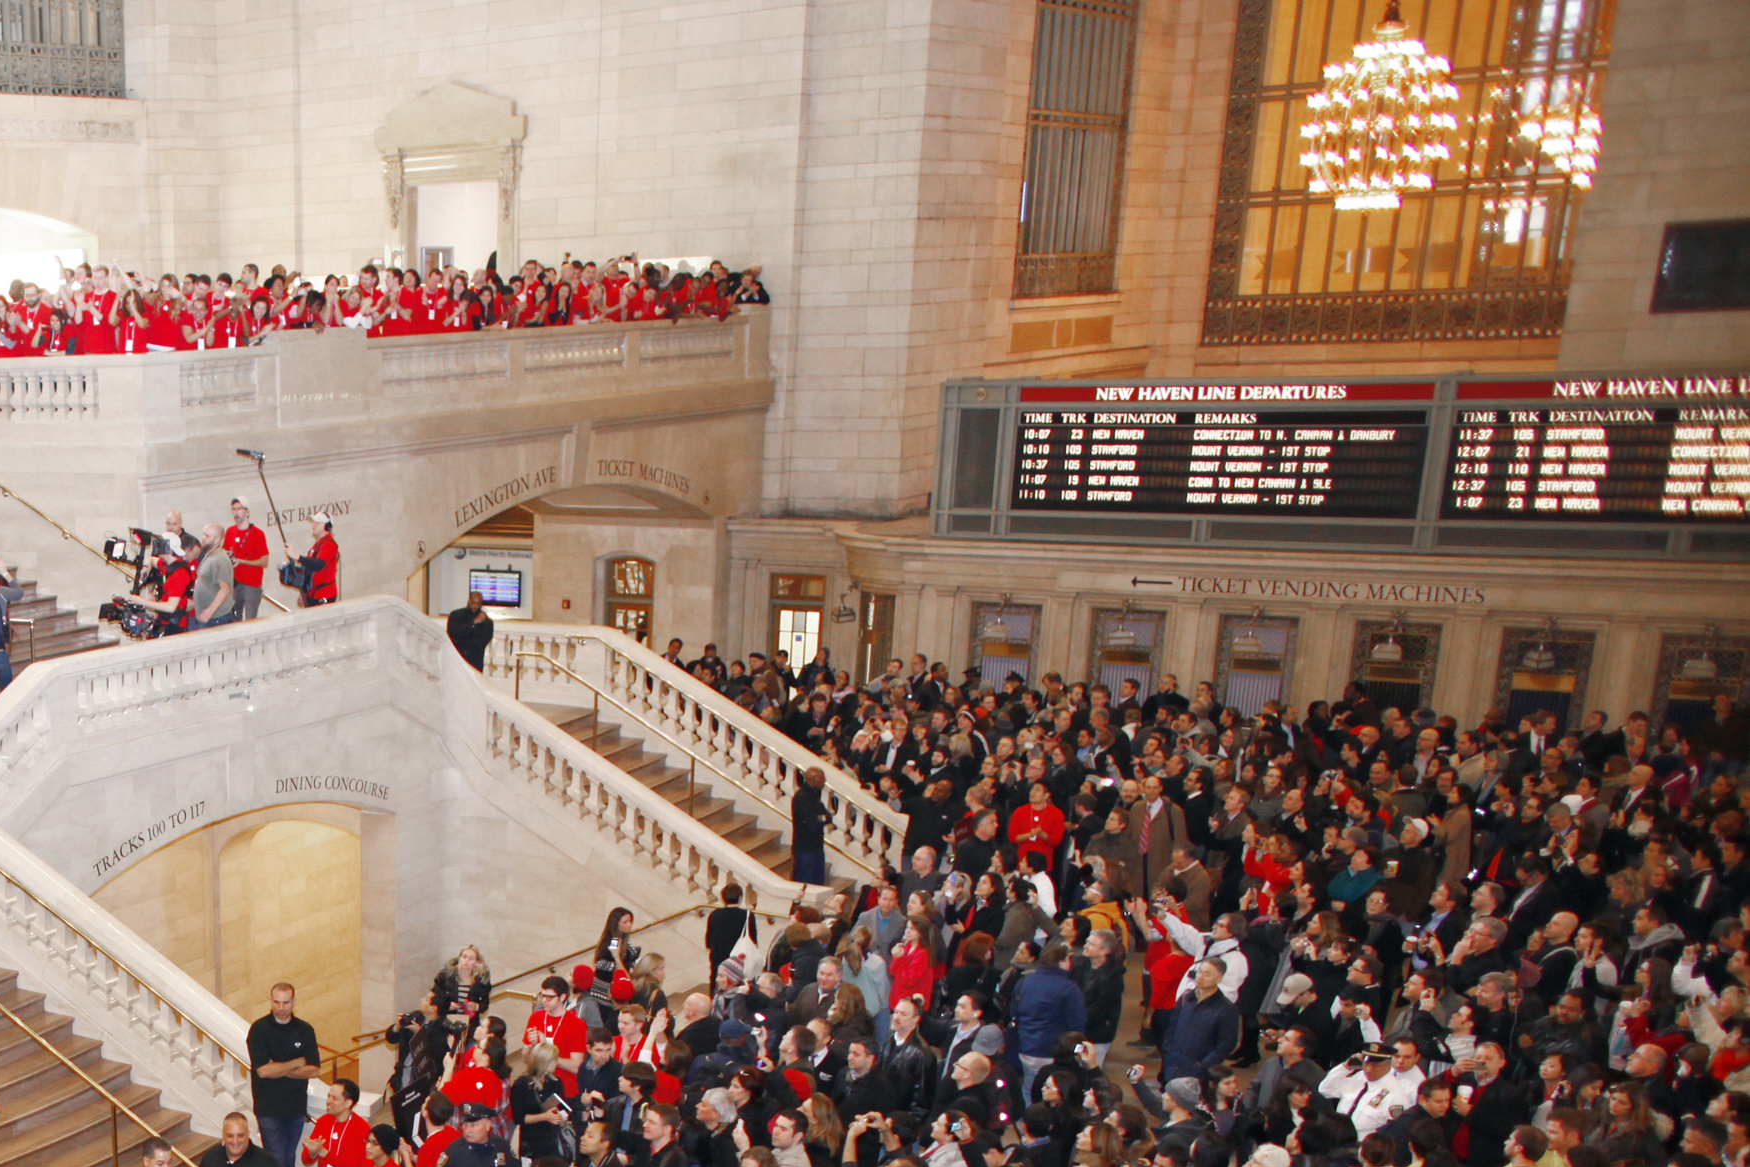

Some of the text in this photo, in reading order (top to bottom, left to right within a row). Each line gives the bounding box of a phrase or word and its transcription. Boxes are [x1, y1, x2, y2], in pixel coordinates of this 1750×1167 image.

[1095, 385, 1348, 401] NEW HAVEN LINE DEPARTURES
[1553, 382, 1601, 397] NEW
[1606, 379, 1678, 396] HAVEN
[1684, 378, 1732, 395] LINE
[1024, 413, 1257, 424] TIME TRK DESTINATION REMARKS
[1462, 411, 1497, 423] TIME
[1509, 411, 1540, 423] TRK
[1550, 410, 1655, 422] DESTINATION
[1024, 429, 1051, 440] 10:07
[1071, 429, 1084, 440] 23
[1092, 429, 1111, 440] NEW
[1114, 429, 1145, 440] HAVEN
[1193, 430, 1254, 441] CONNECTION
[1259, 430, 1272, 440] TO
[1294, 430, 1333, 441] CANAAN
[1350, 430, 1396, 441] DANBURY
[1459, 429, 1494, 440] 11:37
[1513, 429, 1535, 440] 105
[1546, 428, 1606, 440] STAMFORD
[1674, 428, 1715, 440] MOUNT
[1022, 445, 1050, 455] 10:10
[1091, 445, 1138, 455] STAMFORD
[1191, 446, 1223, 456] MOUNT
[1227, 446, 1264, 456] VERNON
[1304, 446, 1331, 457] STOP
[1457, 446, 1750, 457] 12:07 21 NEW HAVEN CONNECTION
[1021, 460, 1049, 470] 10:37
[1063, 460, 1081, 470] 105
[1089, 460, 1136, 471] STAMFORD
[1189, 462, 1221, 472] MOUNT
[1225, 462, 1262, 472] VERNON
[1302, 462, 1329, 473] STOP
[1454, 463, 1489, 474] 12:10
[1508, 463, 1529, 474] 110
[1540, 463, 1563, 474] NEW
[1568, 463, 1606, 474] HAVEN
[1668, 463, 1709, 475] MOUNT
[597, 459, 690, 494] TICKET MACHINES
[1020, 475, 1047, 485] 11:07
[1067, 475, 1079, 485] 19
[1088, 475, 1107, 486] NEW
[1110, 475, 1140, 486] HAVEN
[1188, 477, 1213, 488] CONN
[1218, 478, 1231, 488] TO
[1234, 478, 1254, 488] NEW
[1258, 478, 1295, 488] CANAAN
[1312, 479, 1332, 489] SLE
[1452, 480, 1486, 491] 12:37
[1505, 480, 1526, 491] 105
[1537, 480, 1596, 492] STAMFORD
[1665, 481, 1705, 493] MOUNT
[454, 465, 556, 528] LEXINGTON AVE
[1019, 490, 1046, 500] 11:10
[1086, 490, 1132, 501] STAMFORD
[1186, 493, 1217, 504] MOUNT
[1221, 493, 1258, 504] VERNON
[1298, 494, 1325, 505] STOP
[1455, 497, 1483, 508] 1:07
[1507, 497, 1524, 508] 23
[1534, 498, 1558, 509] NEW
[1562, 498, 1601, 509] HAVEN
[1661, 499, 1687, 510] NEW
[1178, 576, 1485, 604] TICKET VENDING MACHINES
[275, 775, 390, 801] DINING CONCOURSE
[92, 800, 206, 878] TRACKS 100 TO 117
